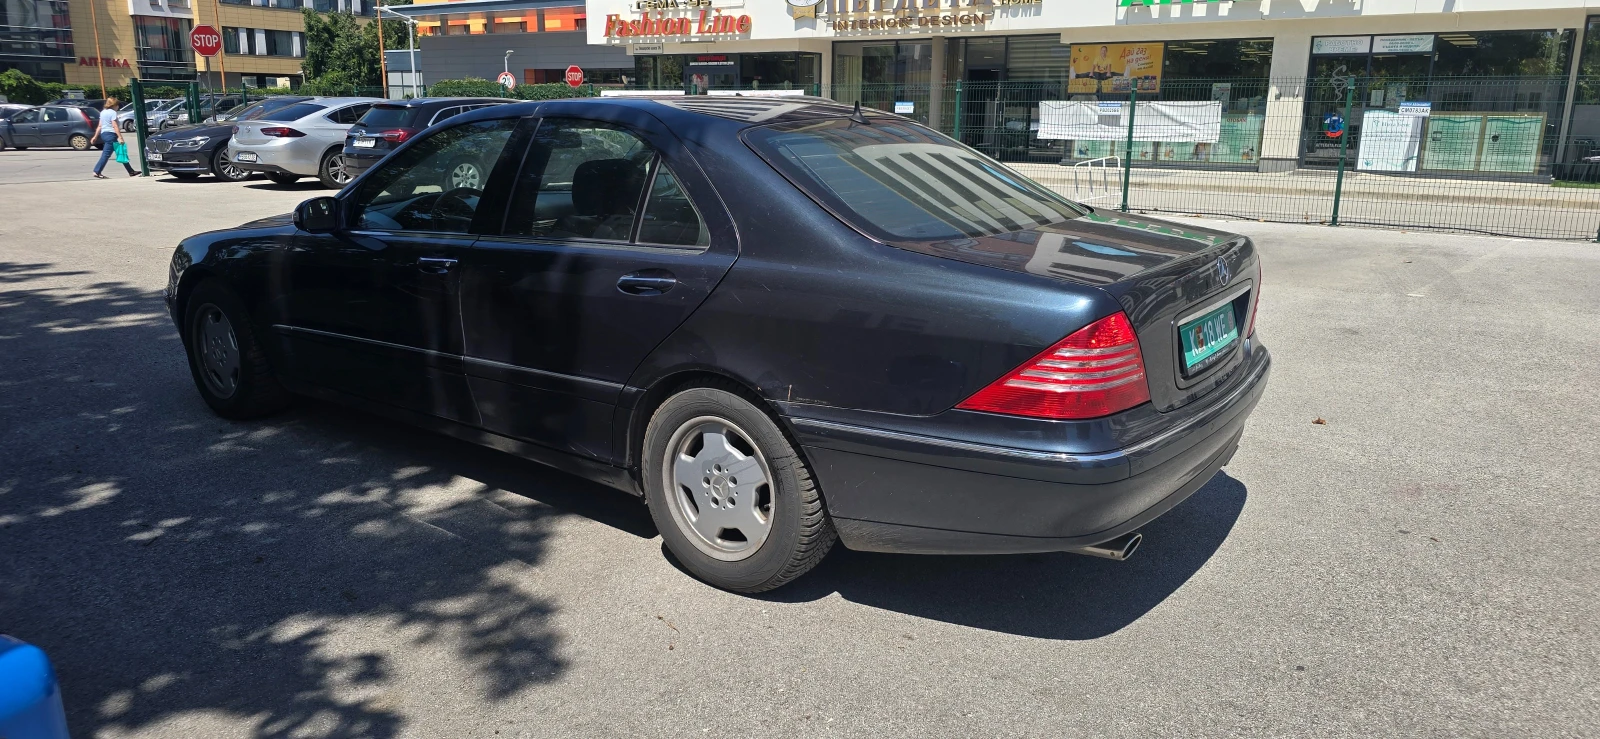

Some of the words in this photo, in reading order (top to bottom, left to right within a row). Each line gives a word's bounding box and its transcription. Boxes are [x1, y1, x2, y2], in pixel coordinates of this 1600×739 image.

[603, 11, 692, 38] Fashion
[696, 7, 751, 34] Line
[832, 16, 912, 31] INTERIOR
[918, 13, 986, 27] DESIGN
[193, 34, 219, 47] STOP
[567, 72, 582, 81] STOP
